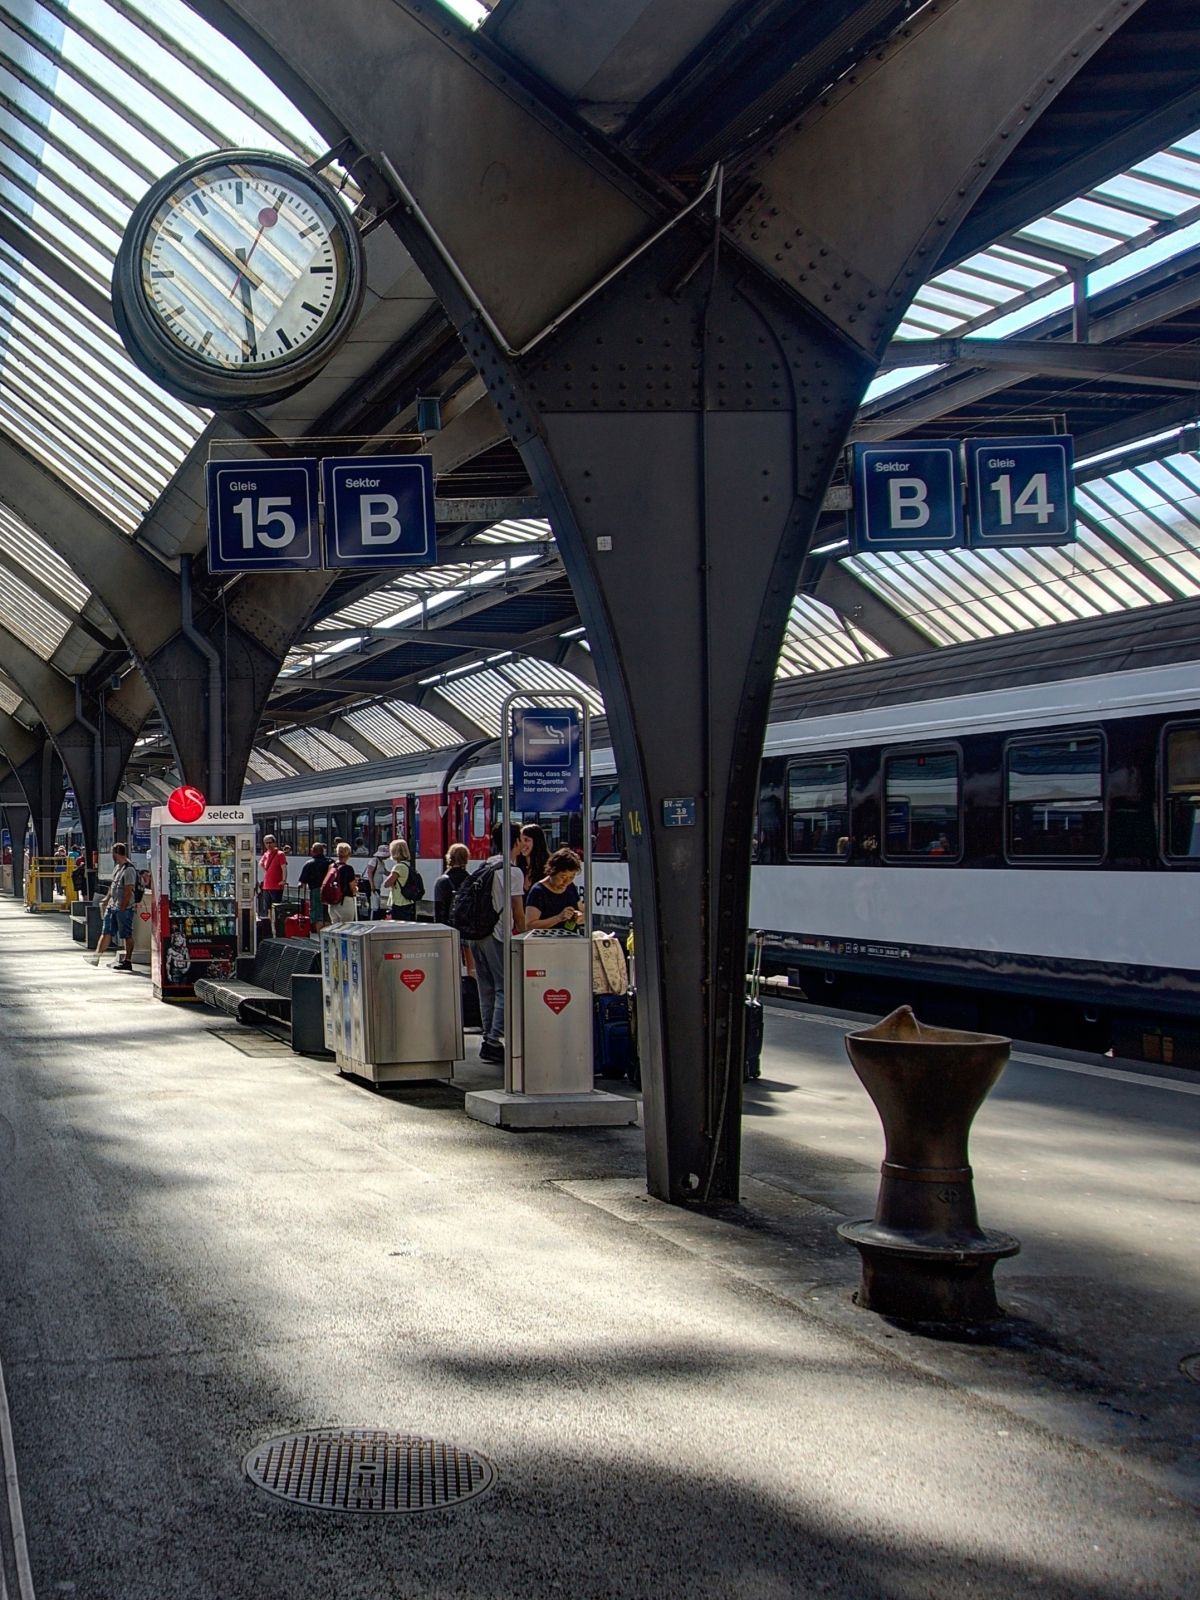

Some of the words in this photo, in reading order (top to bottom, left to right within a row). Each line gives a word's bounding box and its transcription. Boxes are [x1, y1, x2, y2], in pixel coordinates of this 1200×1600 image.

[875, 462, 910, 472] Sektor
[988, 458, 1015, 468] Gleis
[229, 481, 257, 491] Gleis
[345, 478, 380, 488] Sektor
[888, 478, 930, 528] B
[990, 473, 1054, 525] 14
[233, 497, 296, 549] 15
[360, 494, 401, 545] B
[415, 798, 420, 814] 2
[464, 796, 468, 814] 2
[208, 810, 244, 820] selecta
[594, 886, 613, 906] CFF
